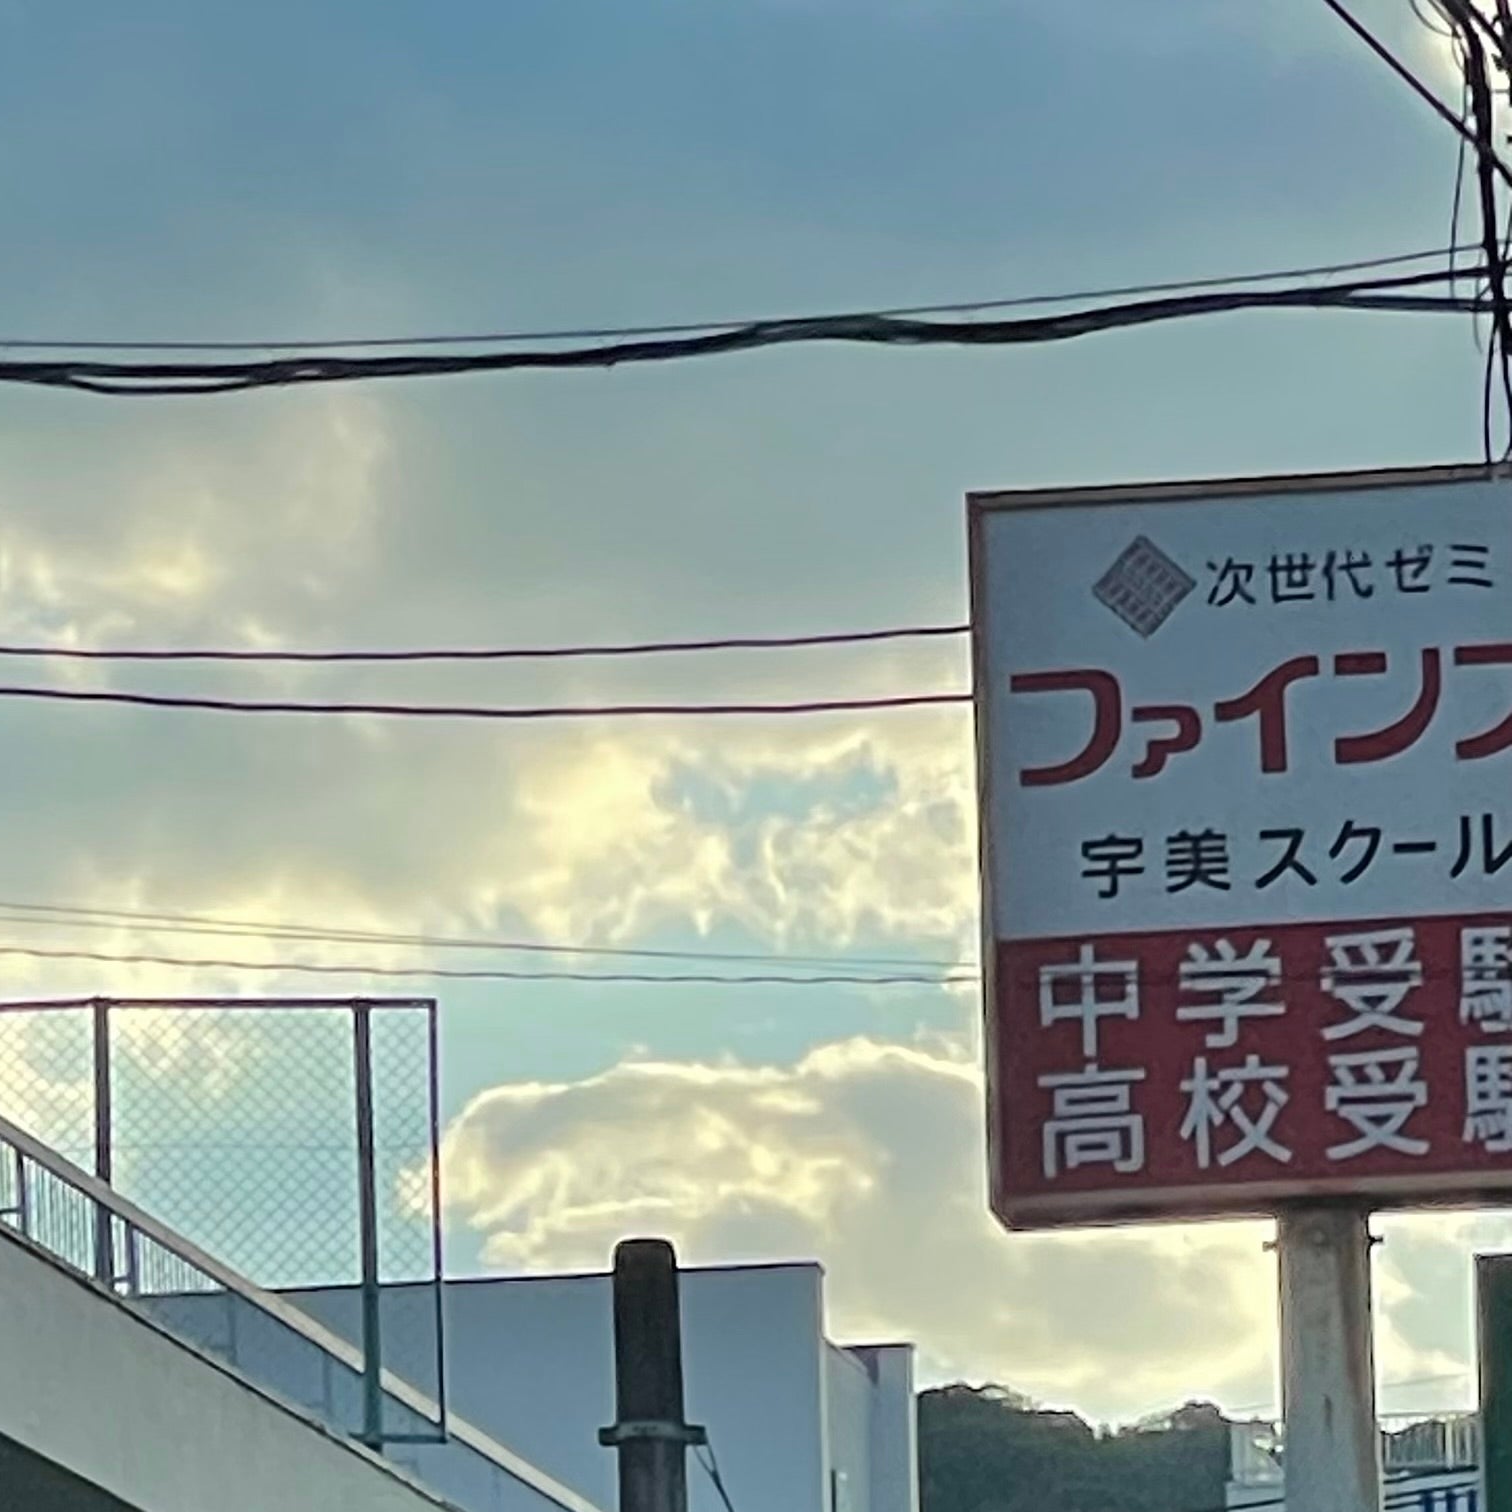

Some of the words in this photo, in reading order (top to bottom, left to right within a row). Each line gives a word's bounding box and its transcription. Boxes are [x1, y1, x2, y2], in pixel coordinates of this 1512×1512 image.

[1204, 542, 1494, 607] 次世代ゼミ
[1080, 812, 1512, 899] 宇美スクール
